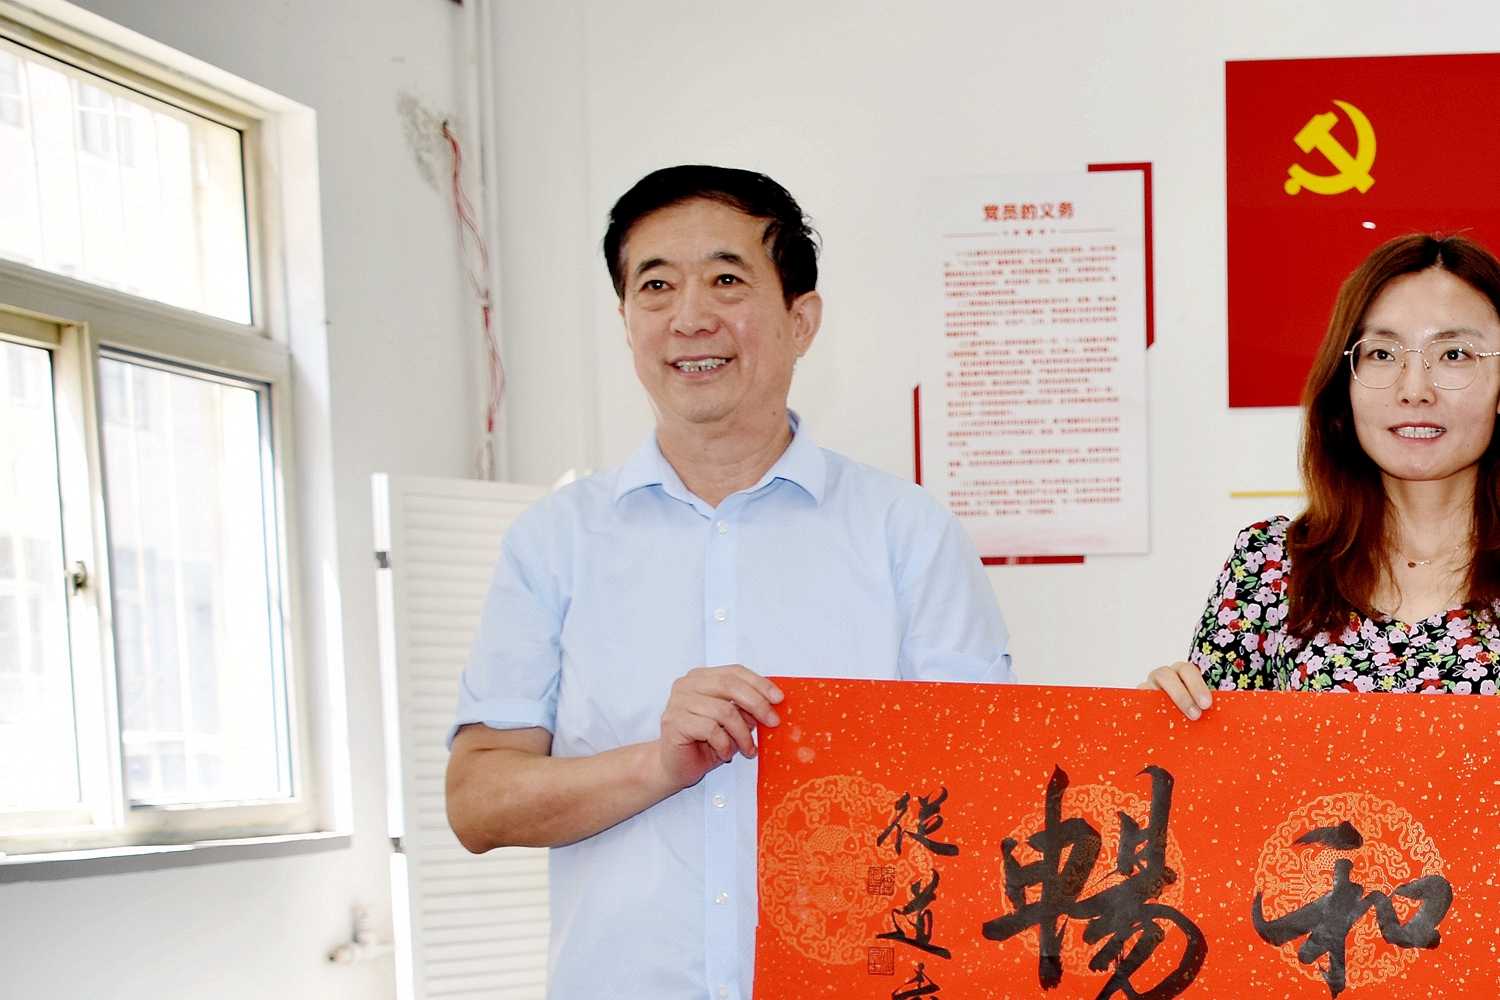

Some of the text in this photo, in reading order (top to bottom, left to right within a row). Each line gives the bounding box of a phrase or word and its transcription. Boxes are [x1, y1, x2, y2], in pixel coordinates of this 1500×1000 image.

[983, 202, 1074, 221] 党员的义务
